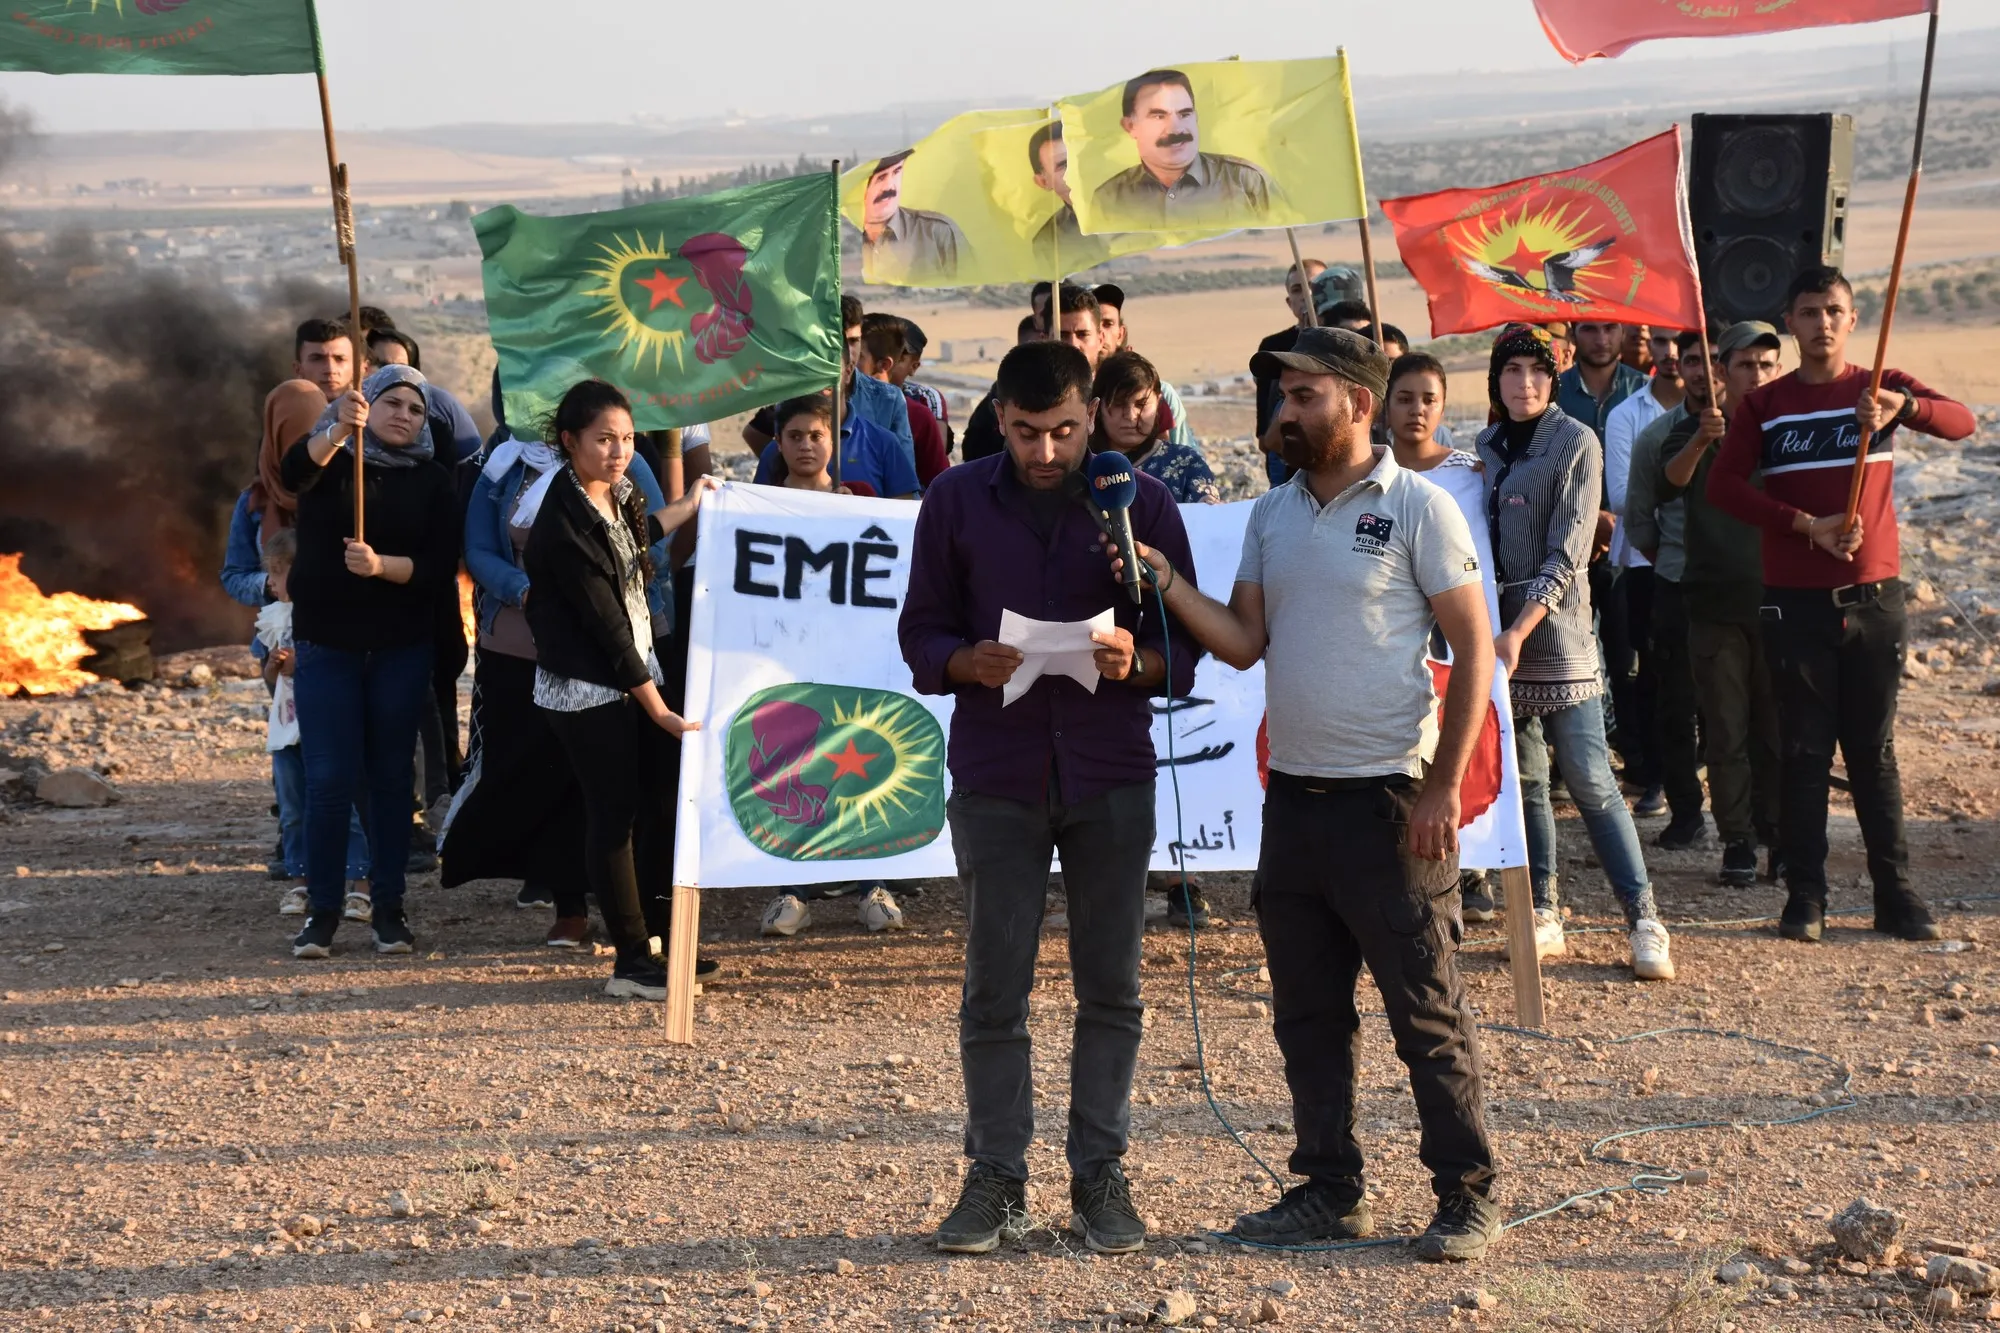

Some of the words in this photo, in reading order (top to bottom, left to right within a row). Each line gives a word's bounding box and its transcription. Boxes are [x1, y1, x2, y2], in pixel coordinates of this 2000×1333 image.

[1773, 430, 1815, 460] Red
[1099, 471, 1131, 488] ANHA
[1351, 546, 1385, 557] AUSTRALIA
[1355, 536, 1387, 548] RUGBY
[733, 524, 899, 609] EMÊ
[1168, 810, 1236, 866] أقليم
